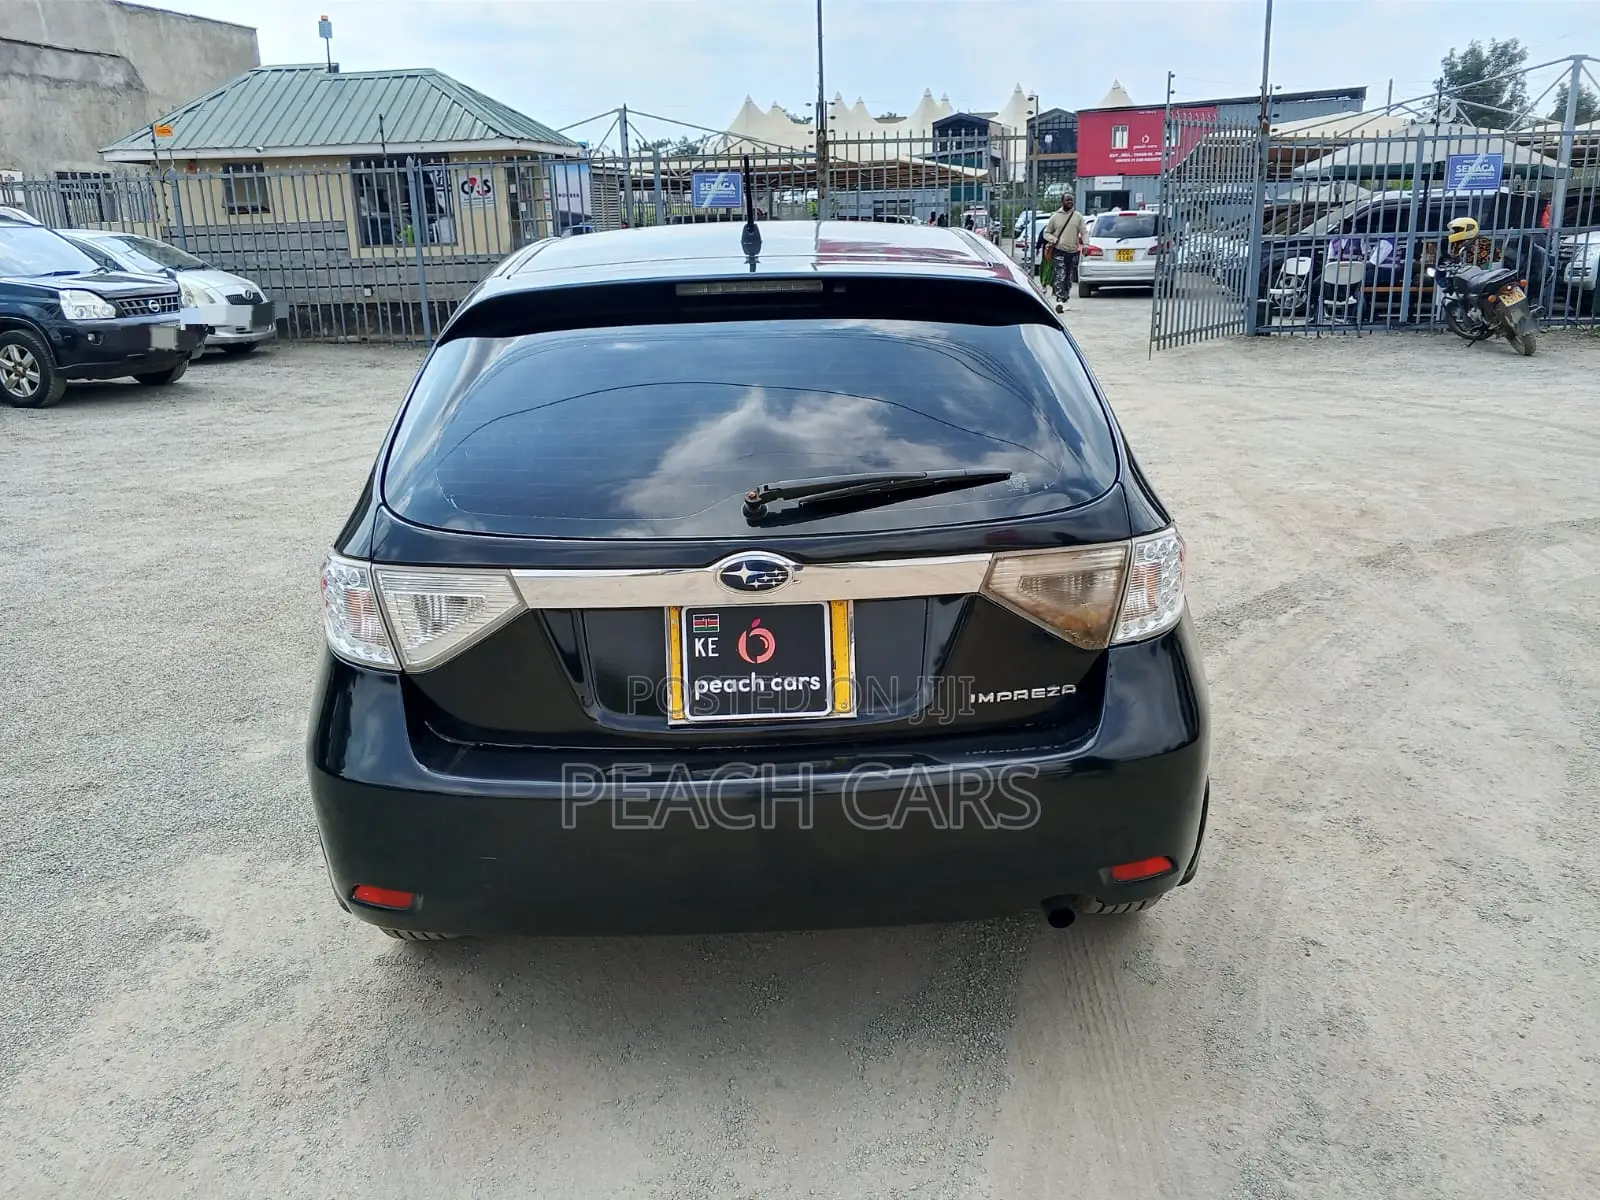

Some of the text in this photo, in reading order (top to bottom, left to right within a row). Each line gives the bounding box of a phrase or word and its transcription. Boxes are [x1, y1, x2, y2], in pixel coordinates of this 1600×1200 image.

[694, 637, 719, 657] KE
[694, 672, 820, 701] peach cars
[970, 684, 1077, 704] IMPREZA
